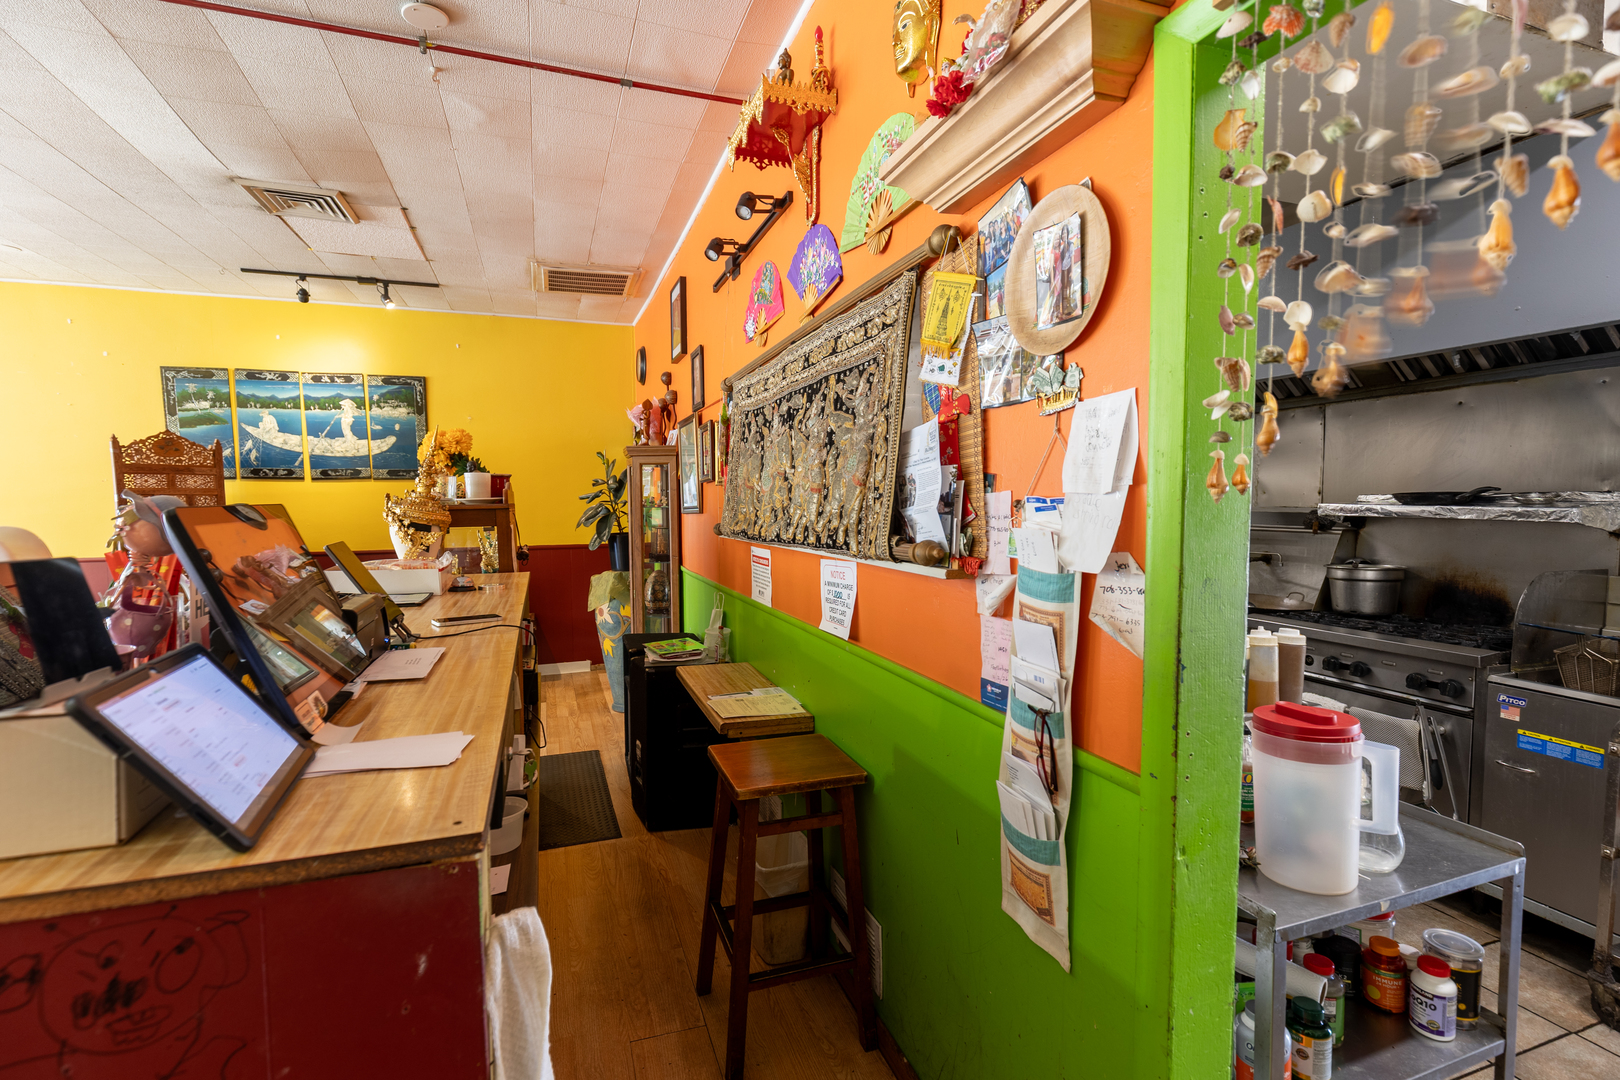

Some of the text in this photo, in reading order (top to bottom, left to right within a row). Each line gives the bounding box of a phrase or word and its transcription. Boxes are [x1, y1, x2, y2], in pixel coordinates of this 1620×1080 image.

[830, 570, 846, 580] NOTICE
[827, 580, 840, 588] MINIMUM
[840, 582, 854, 592] CHARGE
[825, 596, 839, 606] REQUIRED
[829, 614, 845, 626] PURCHASES
[1500, 694, 1526, 706] PITCO
[1372, 975, 1402, 986] IMMUNE
